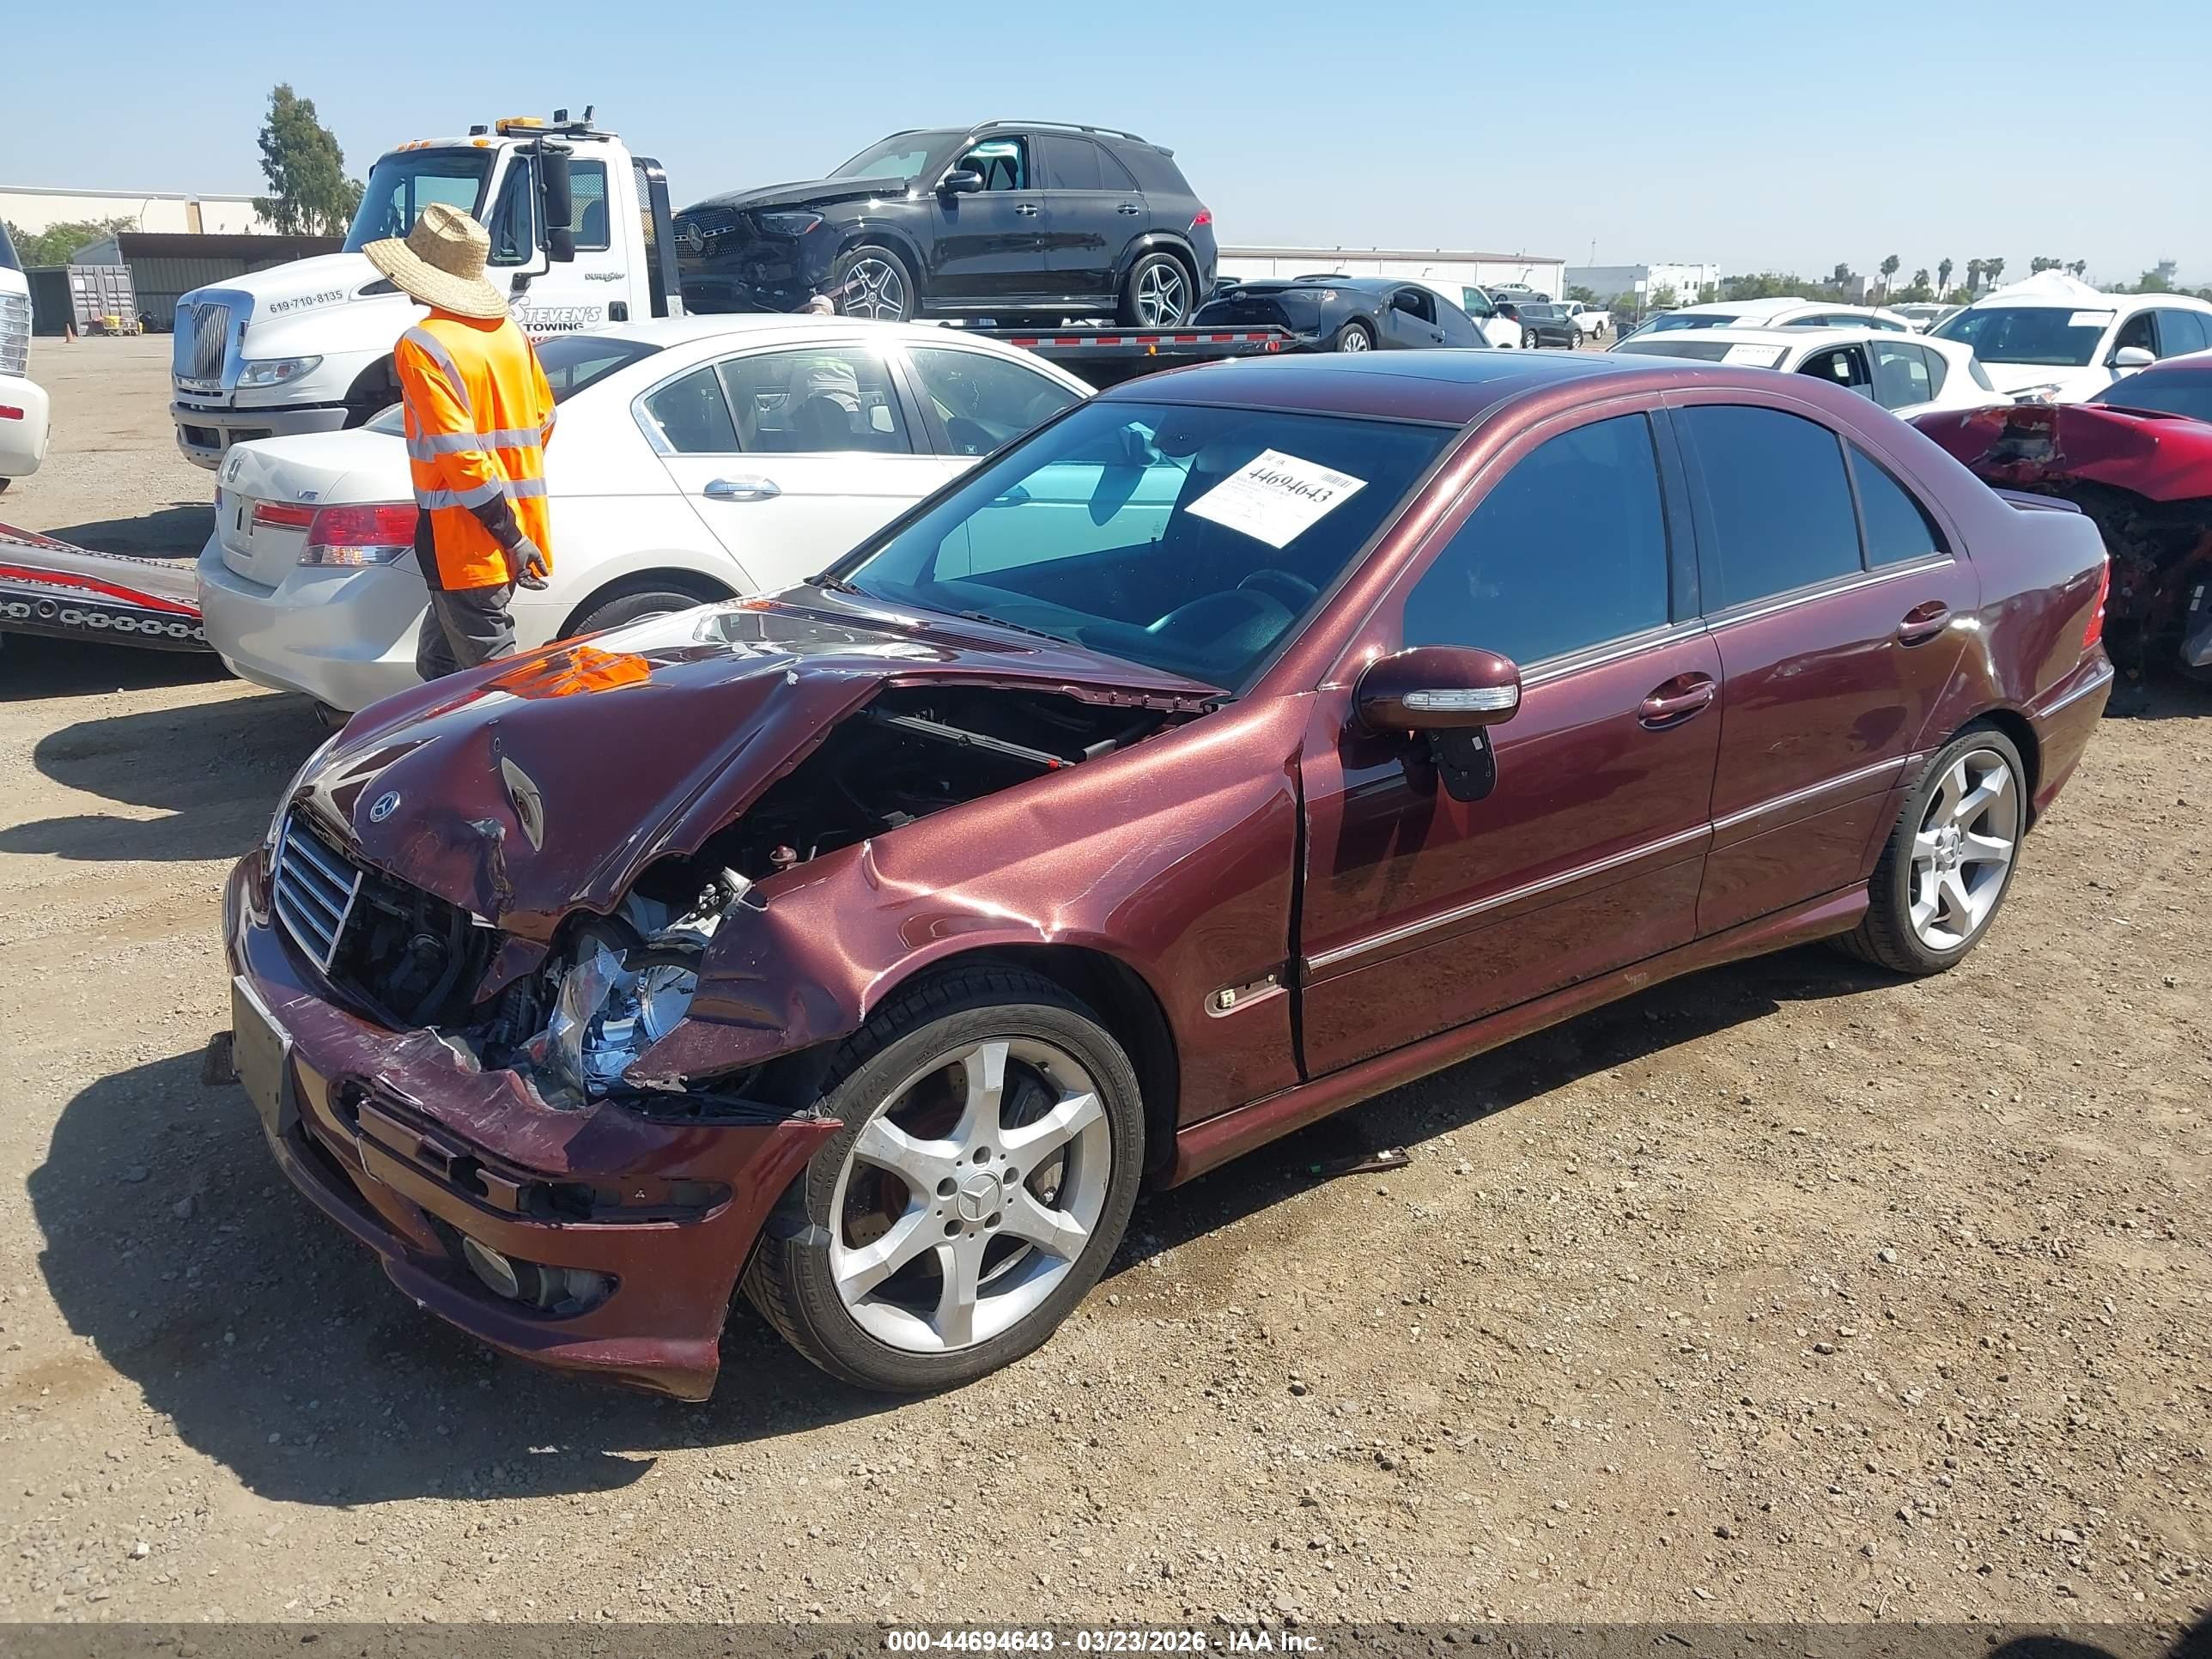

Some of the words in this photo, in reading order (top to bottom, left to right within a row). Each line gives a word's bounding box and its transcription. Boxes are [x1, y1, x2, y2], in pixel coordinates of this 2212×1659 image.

[270, 289, 343, 313] 619-710-8135
[523, 322, 585, 331] TOWING
[1249, 467, 1334, 503] 44694643
[297, 489, 319, 501] V6
